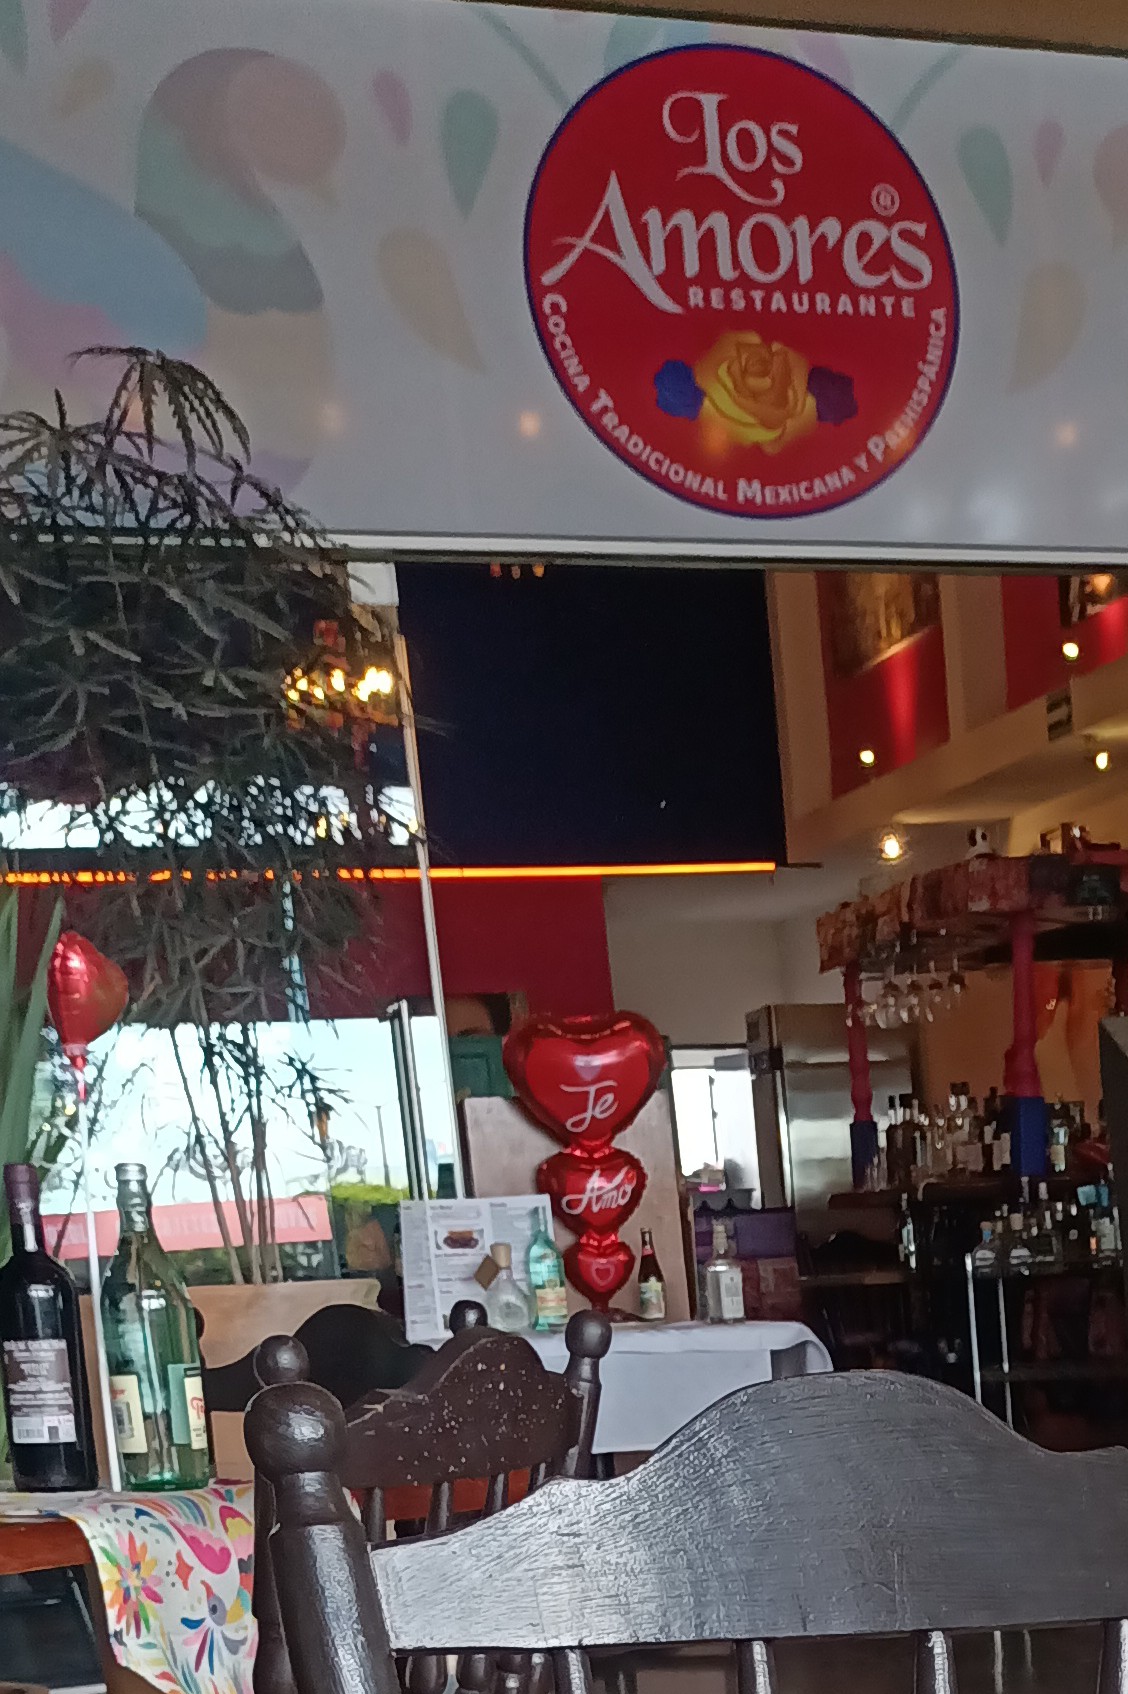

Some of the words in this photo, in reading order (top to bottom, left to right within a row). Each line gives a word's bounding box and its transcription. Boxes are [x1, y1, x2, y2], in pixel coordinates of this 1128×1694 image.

[662, 91, 803, 207] Los
[541, 170, 933, 314] Amores
[688, 286, 915, 318] RESTAURANTE
[561, 1165, 637, 1216] Amo
